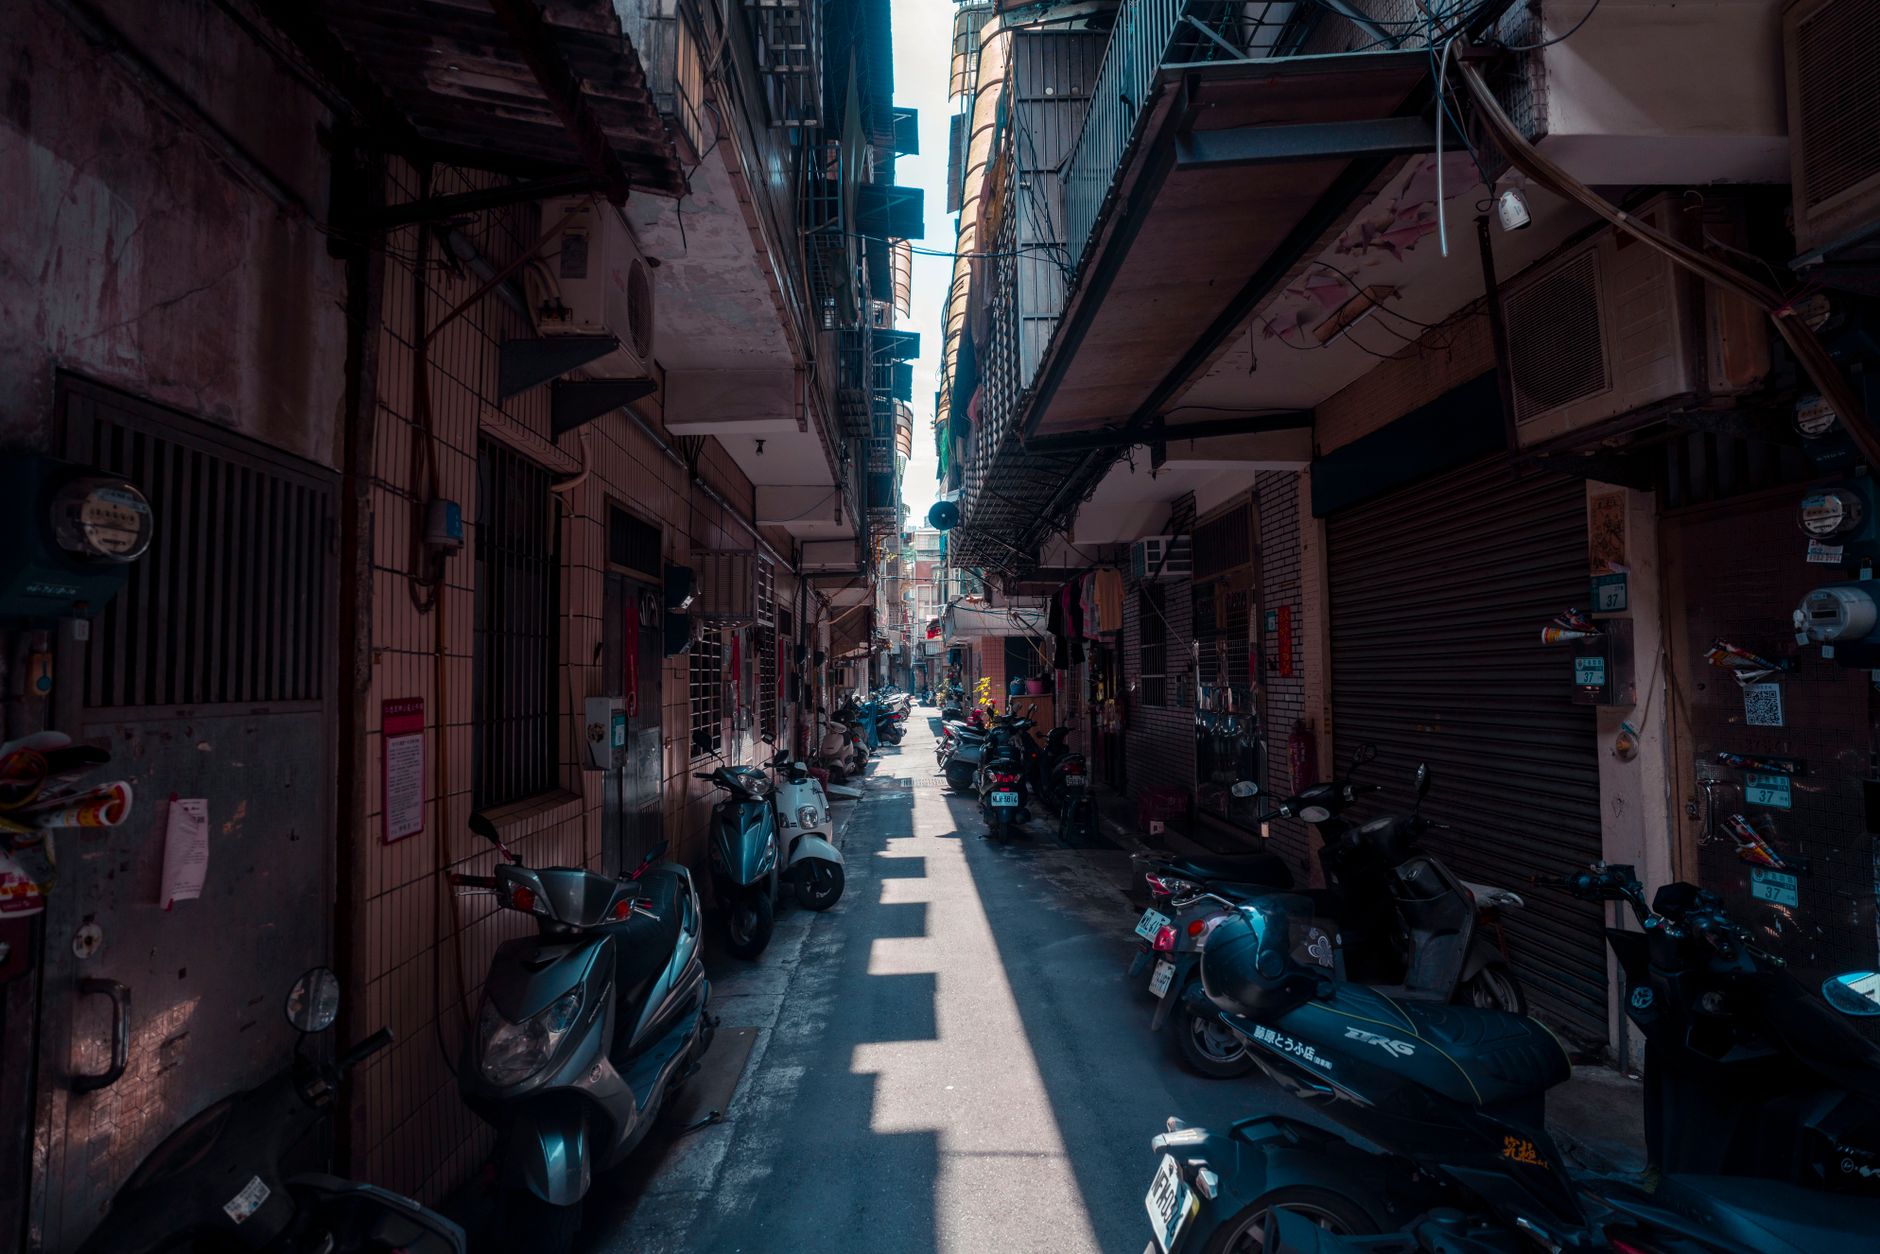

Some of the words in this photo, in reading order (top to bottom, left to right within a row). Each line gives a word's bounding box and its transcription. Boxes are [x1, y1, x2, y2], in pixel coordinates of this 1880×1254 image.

[1606, 593, 1618, 608] 37
[1584, 672, 1594, 683] 37
[1759, 790, 1774, 803] 37
[1765, 886, 1781, 900] 37
